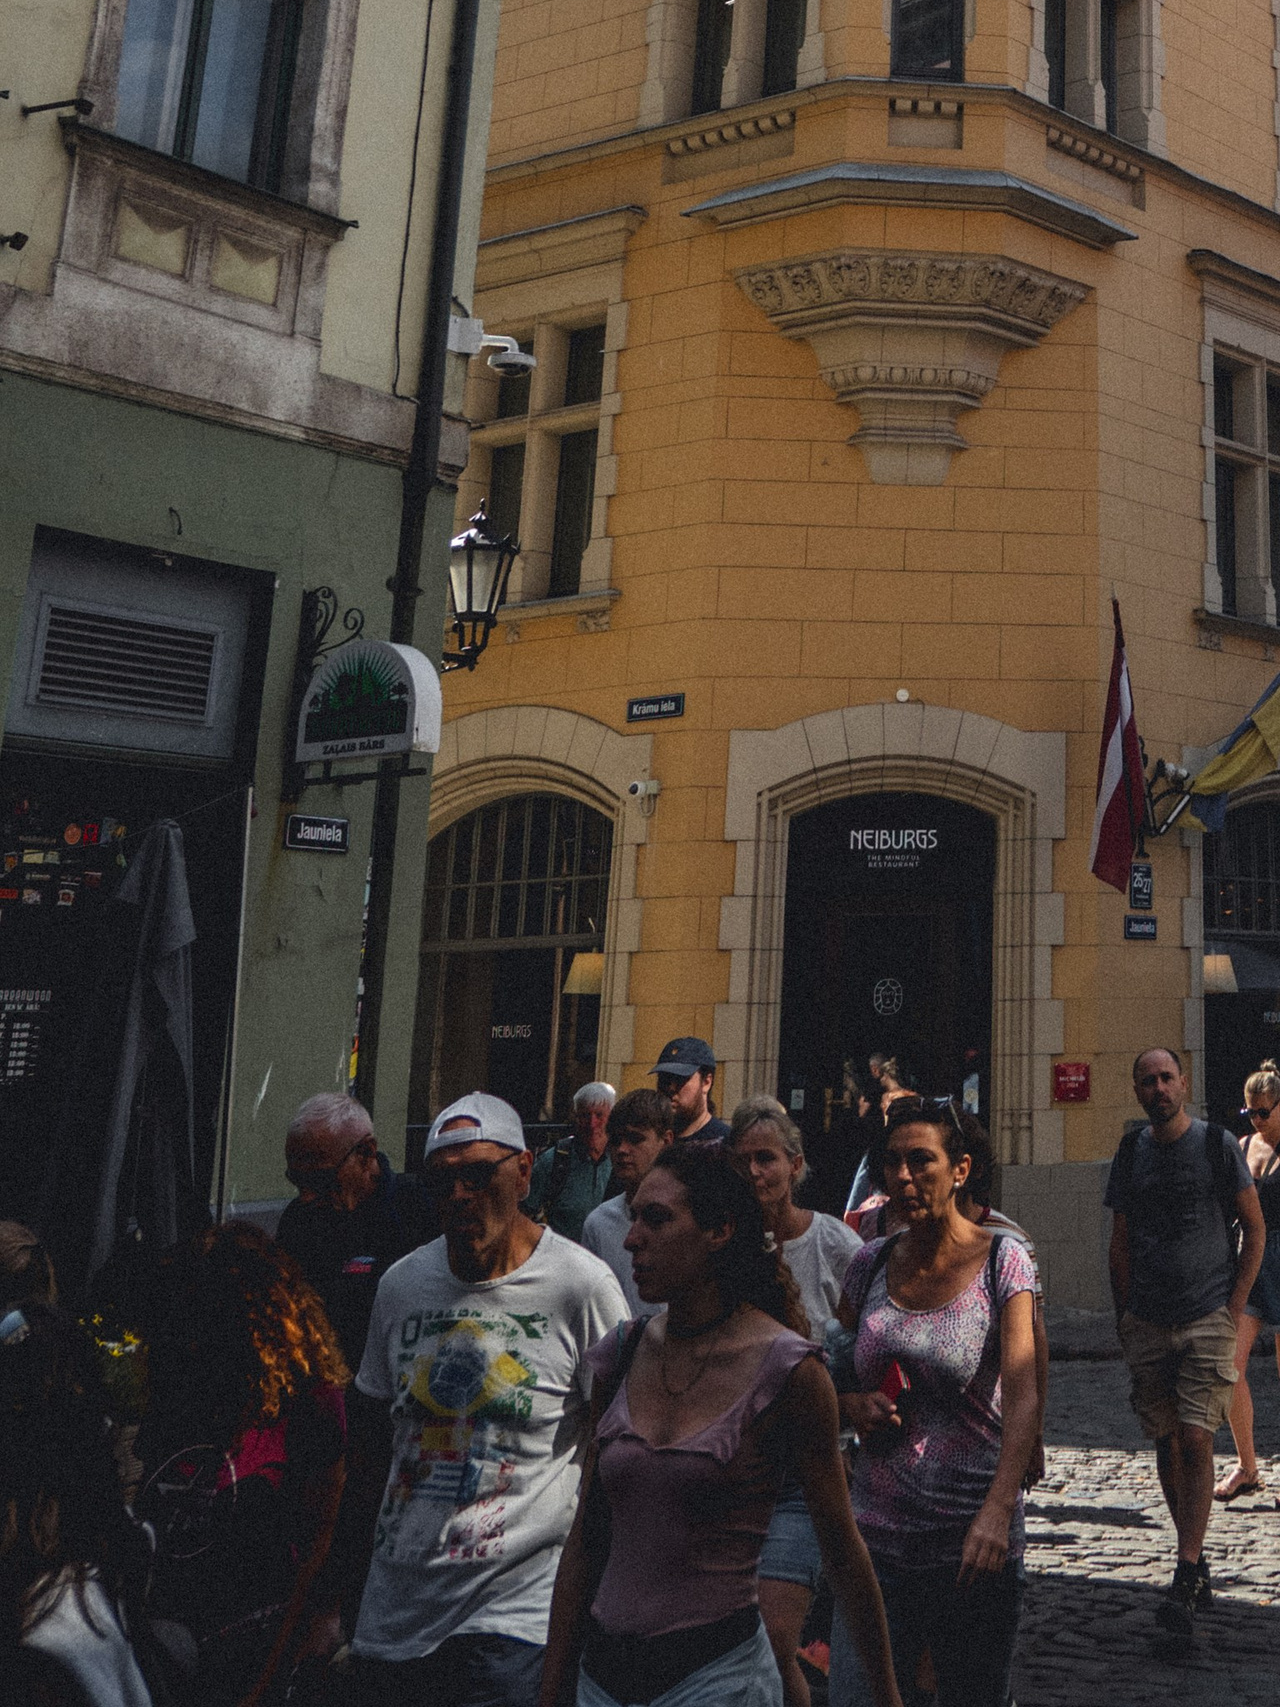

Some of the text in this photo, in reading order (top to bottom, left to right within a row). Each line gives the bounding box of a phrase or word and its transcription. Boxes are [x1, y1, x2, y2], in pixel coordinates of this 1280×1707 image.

[632, 700, 676, 715] Krāmu iela
[322, 739, 385, 755] ZAĻAIS BĀRS
[297, 822, 343, 843] Jauniela
[850, 829, 938, 850] NEIBURGS
[491, 1024, 532, 1039] NEIBURGS
